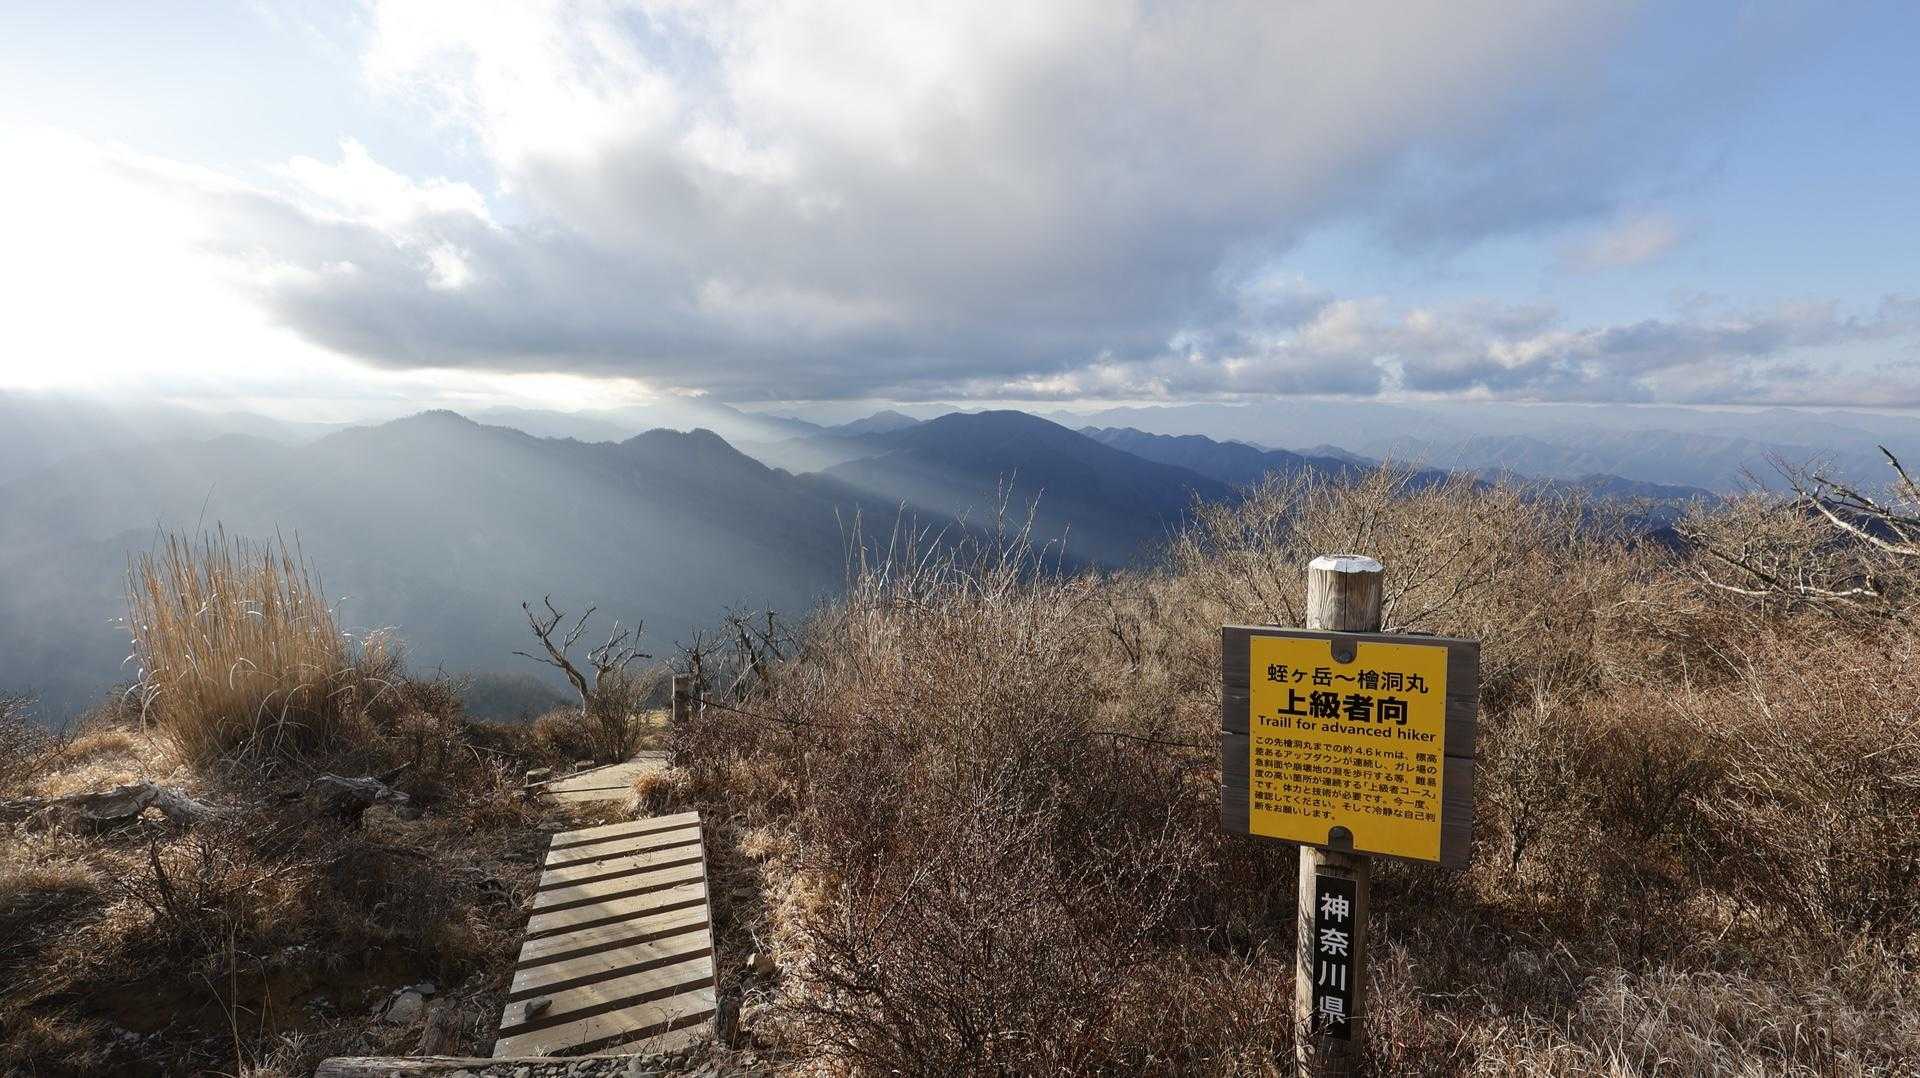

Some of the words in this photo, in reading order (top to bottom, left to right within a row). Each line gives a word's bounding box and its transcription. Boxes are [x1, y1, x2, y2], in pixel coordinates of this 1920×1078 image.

[1277, 688, 1409, 725] 上級者向
[1257, 715, 1292, 729] Traill
[1296, 718, 1317, 731] for
[1321, 721, 1392, 739] advanced
[1397, 726, 1436, 743] hiker
[1318, 892, 1350, 1025] 神奈川県
